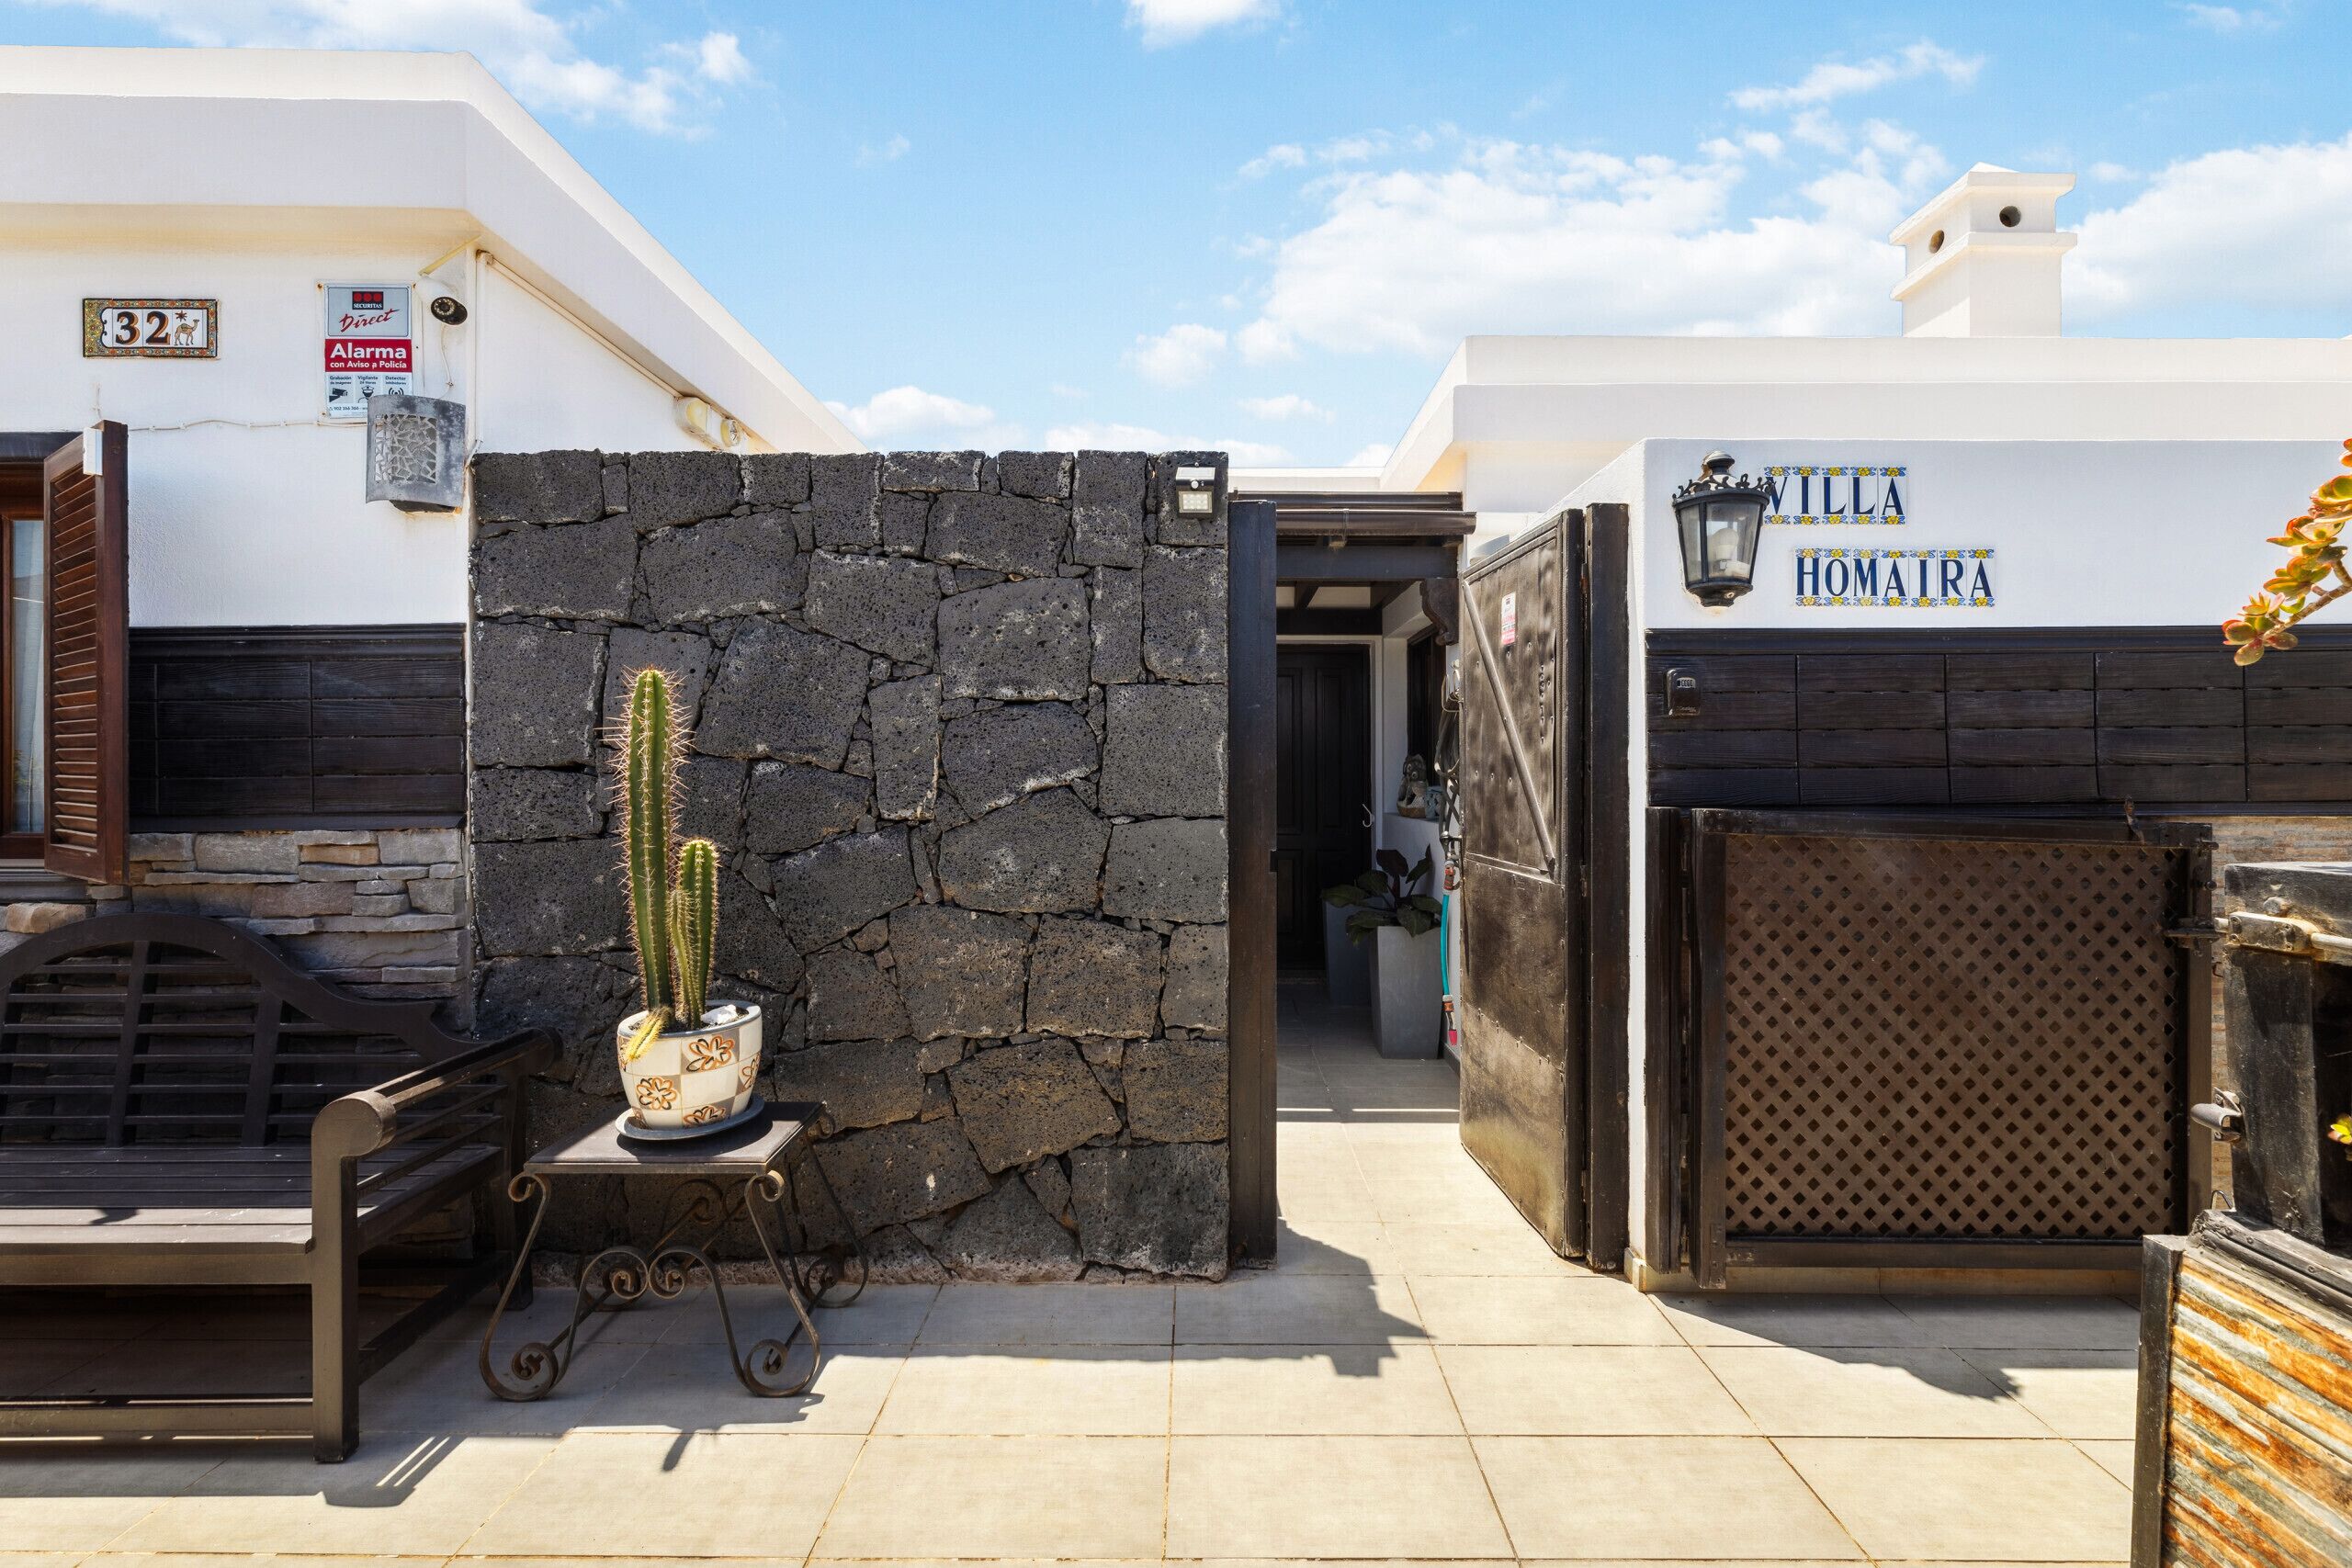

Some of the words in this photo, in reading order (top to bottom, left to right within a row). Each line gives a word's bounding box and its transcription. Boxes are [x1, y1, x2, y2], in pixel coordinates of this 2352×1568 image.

[115, 310, 171, 345] 32
[339, 308, 400, 333] Direct
[330, 343, 407, 359] Alarma
[346, 360, 369, 368] Aviso
[379, 360, 407, 368] Policía
[1766, 475, 1905, 516] VILLA
[1796, 557, 1994, 599] HOMAIRA
